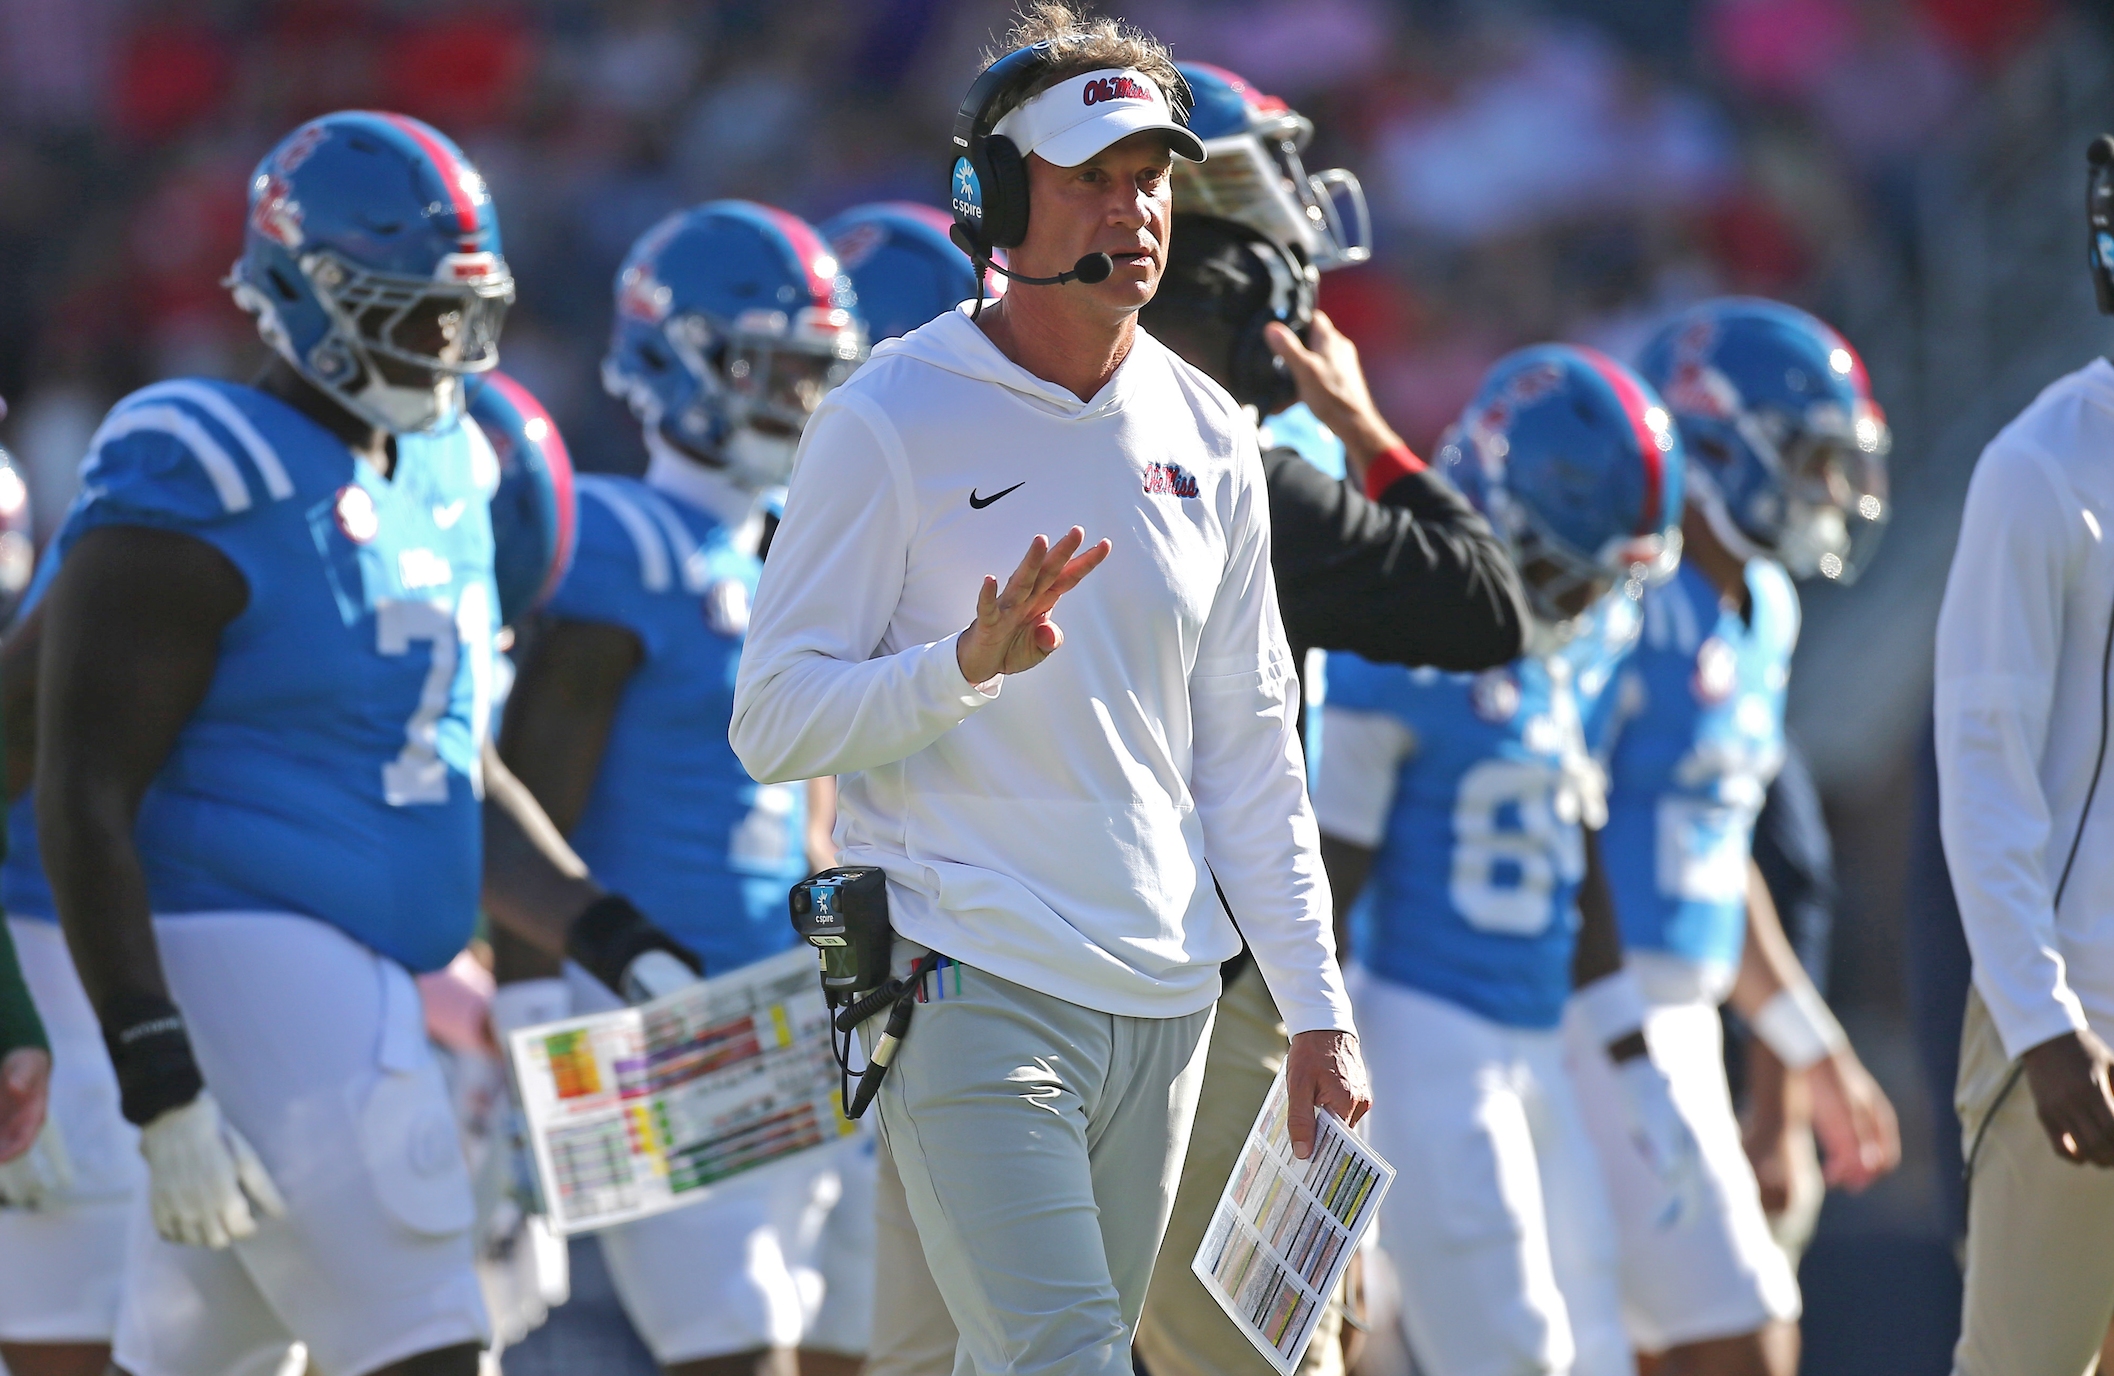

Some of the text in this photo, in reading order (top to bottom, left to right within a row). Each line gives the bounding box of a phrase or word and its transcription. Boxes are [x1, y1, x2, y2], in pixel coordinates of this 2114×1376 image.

[1083, 77, 1154, 106] Ole Miss
[1143, 461, 1199, 499] Ole Miss
